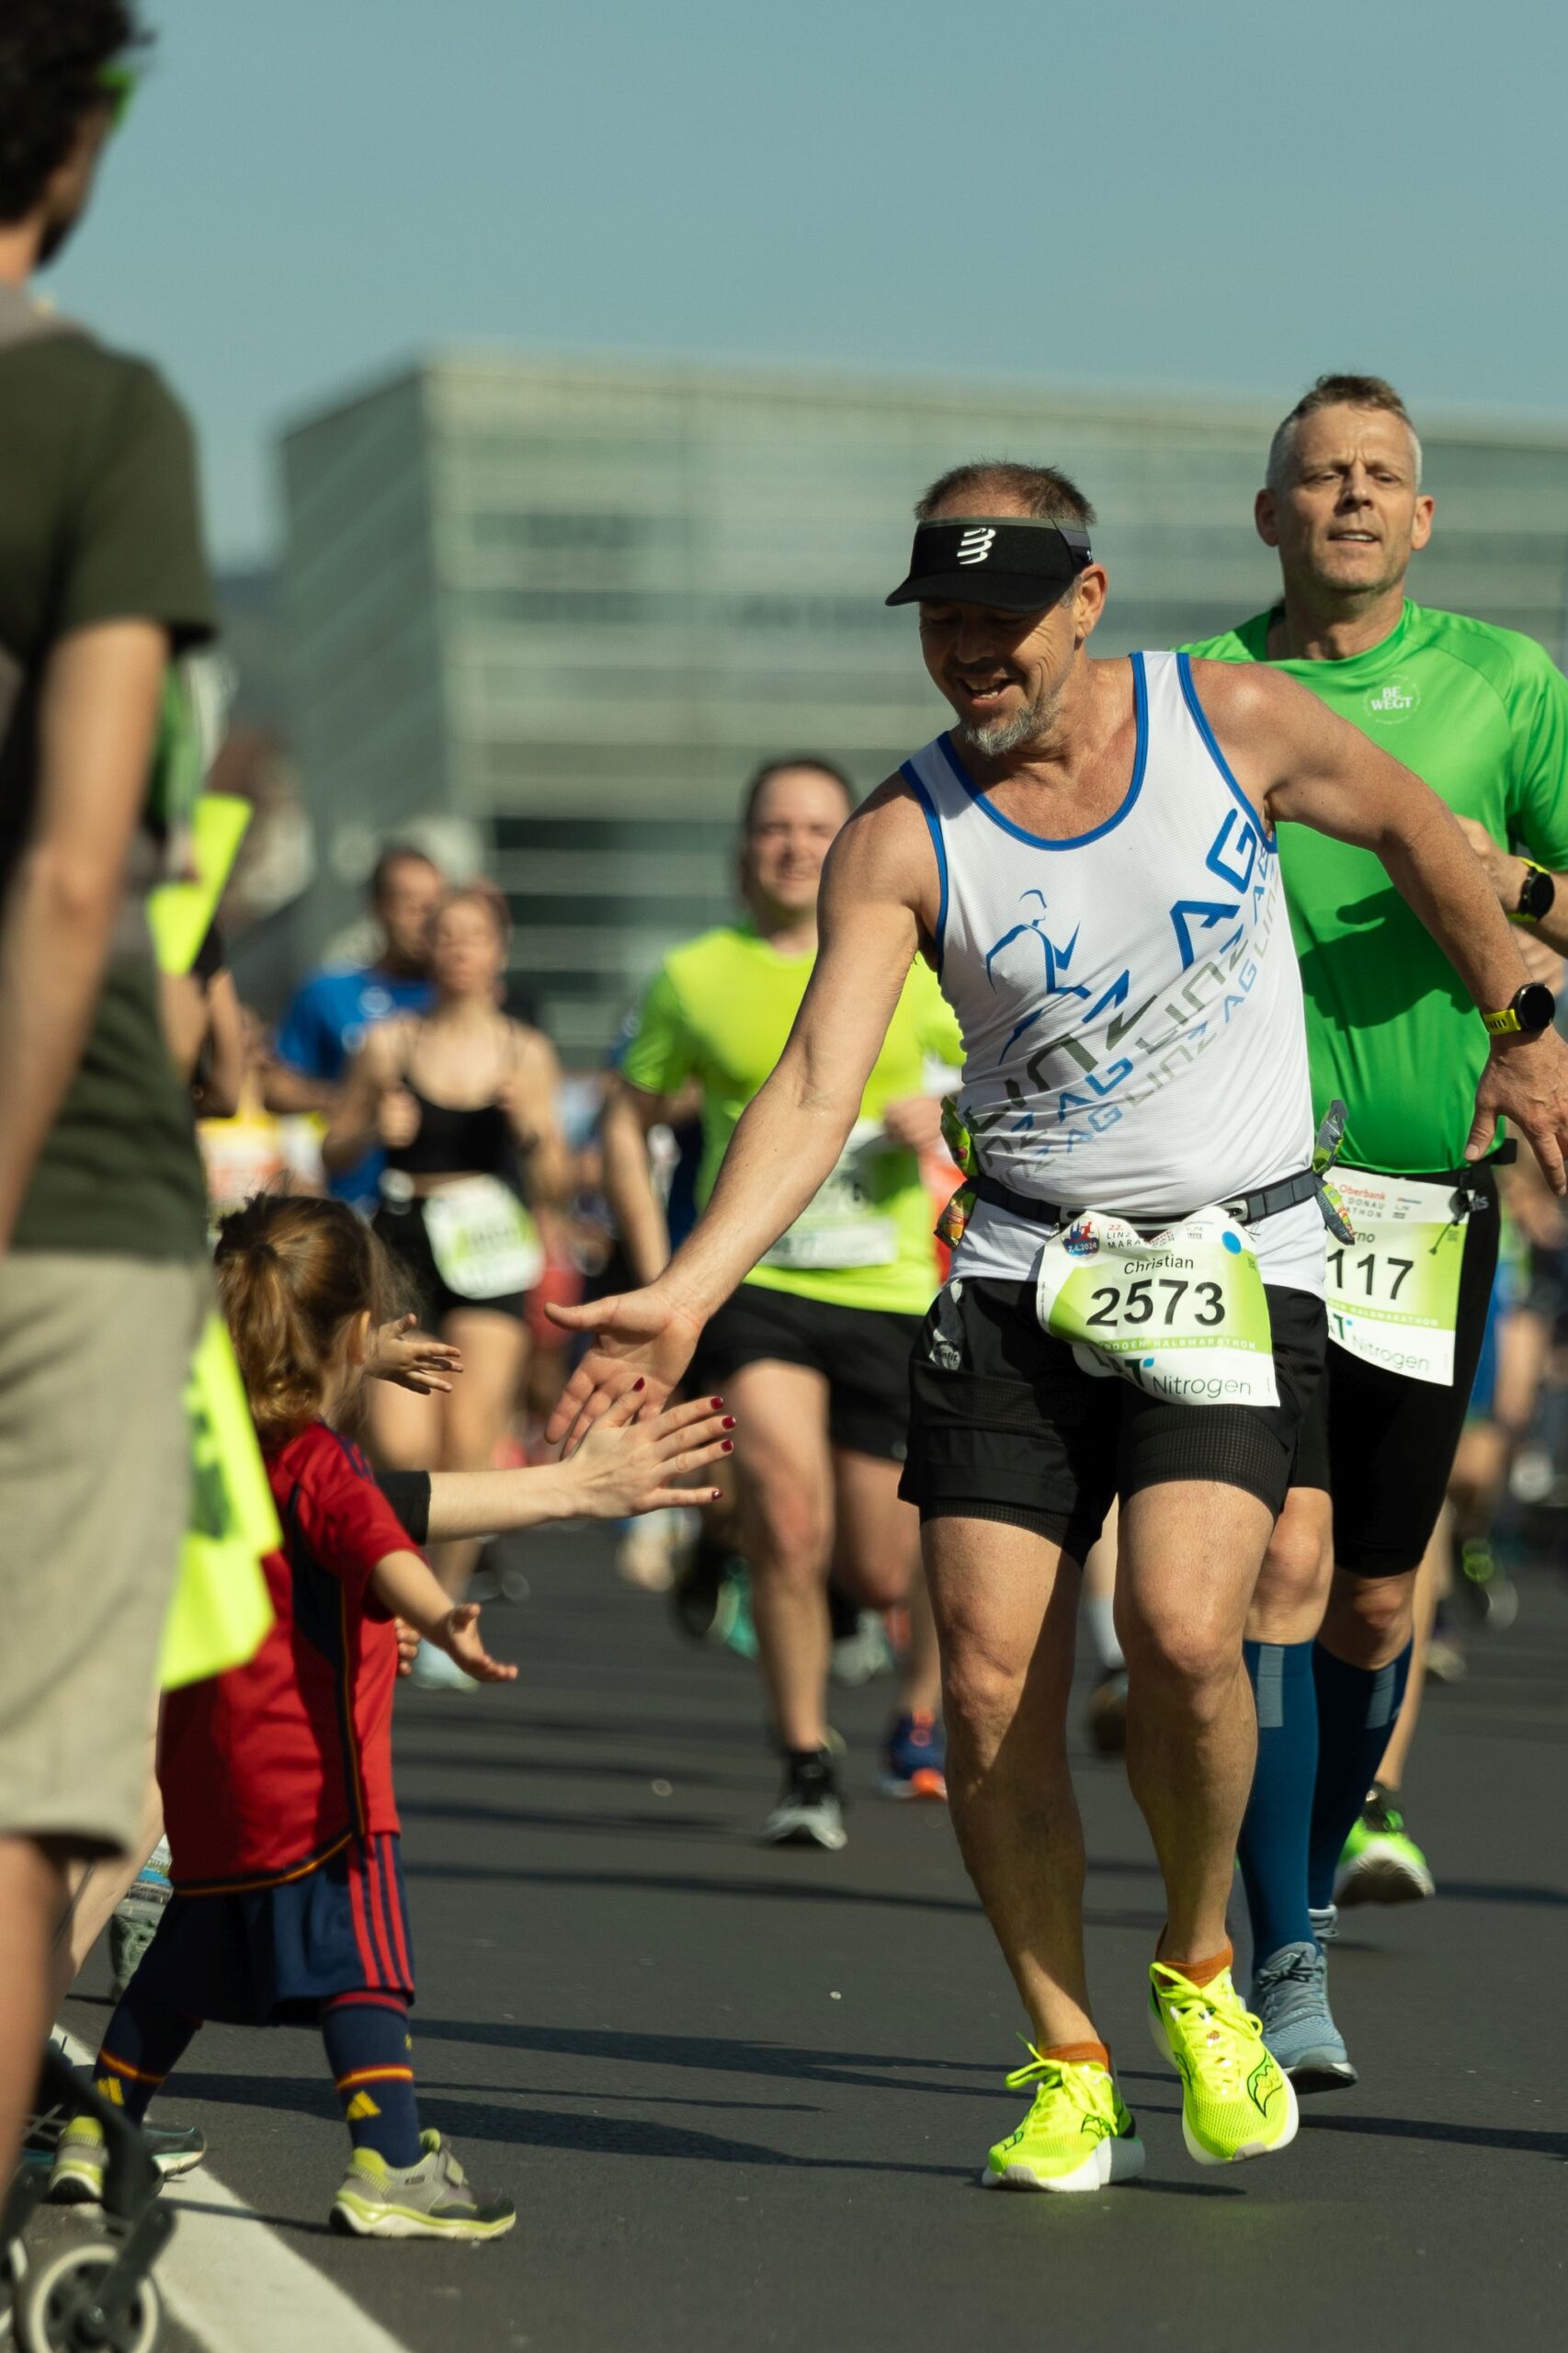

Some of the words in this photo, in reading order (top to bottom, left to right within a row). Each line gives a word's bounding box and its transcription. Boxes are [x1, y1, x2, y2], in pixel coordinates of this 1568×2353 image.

[1382, 686, 1402, 697] BE
[1371, 696, 1413, 710] WEGT
[1170, 808, 1257, 972] AG
[1345, 1206, 1382, 1219] ATHON
[1124, 1253, 1194, 1275] Christian
[1327, 1248, 1415, 1301] 117
[1085, 1279, 1226, 1327] 2573
[1153, 1336, 1256, 1350] HALBMARATHON
[1152, 1374, 1251, 1399] Nitrogen
